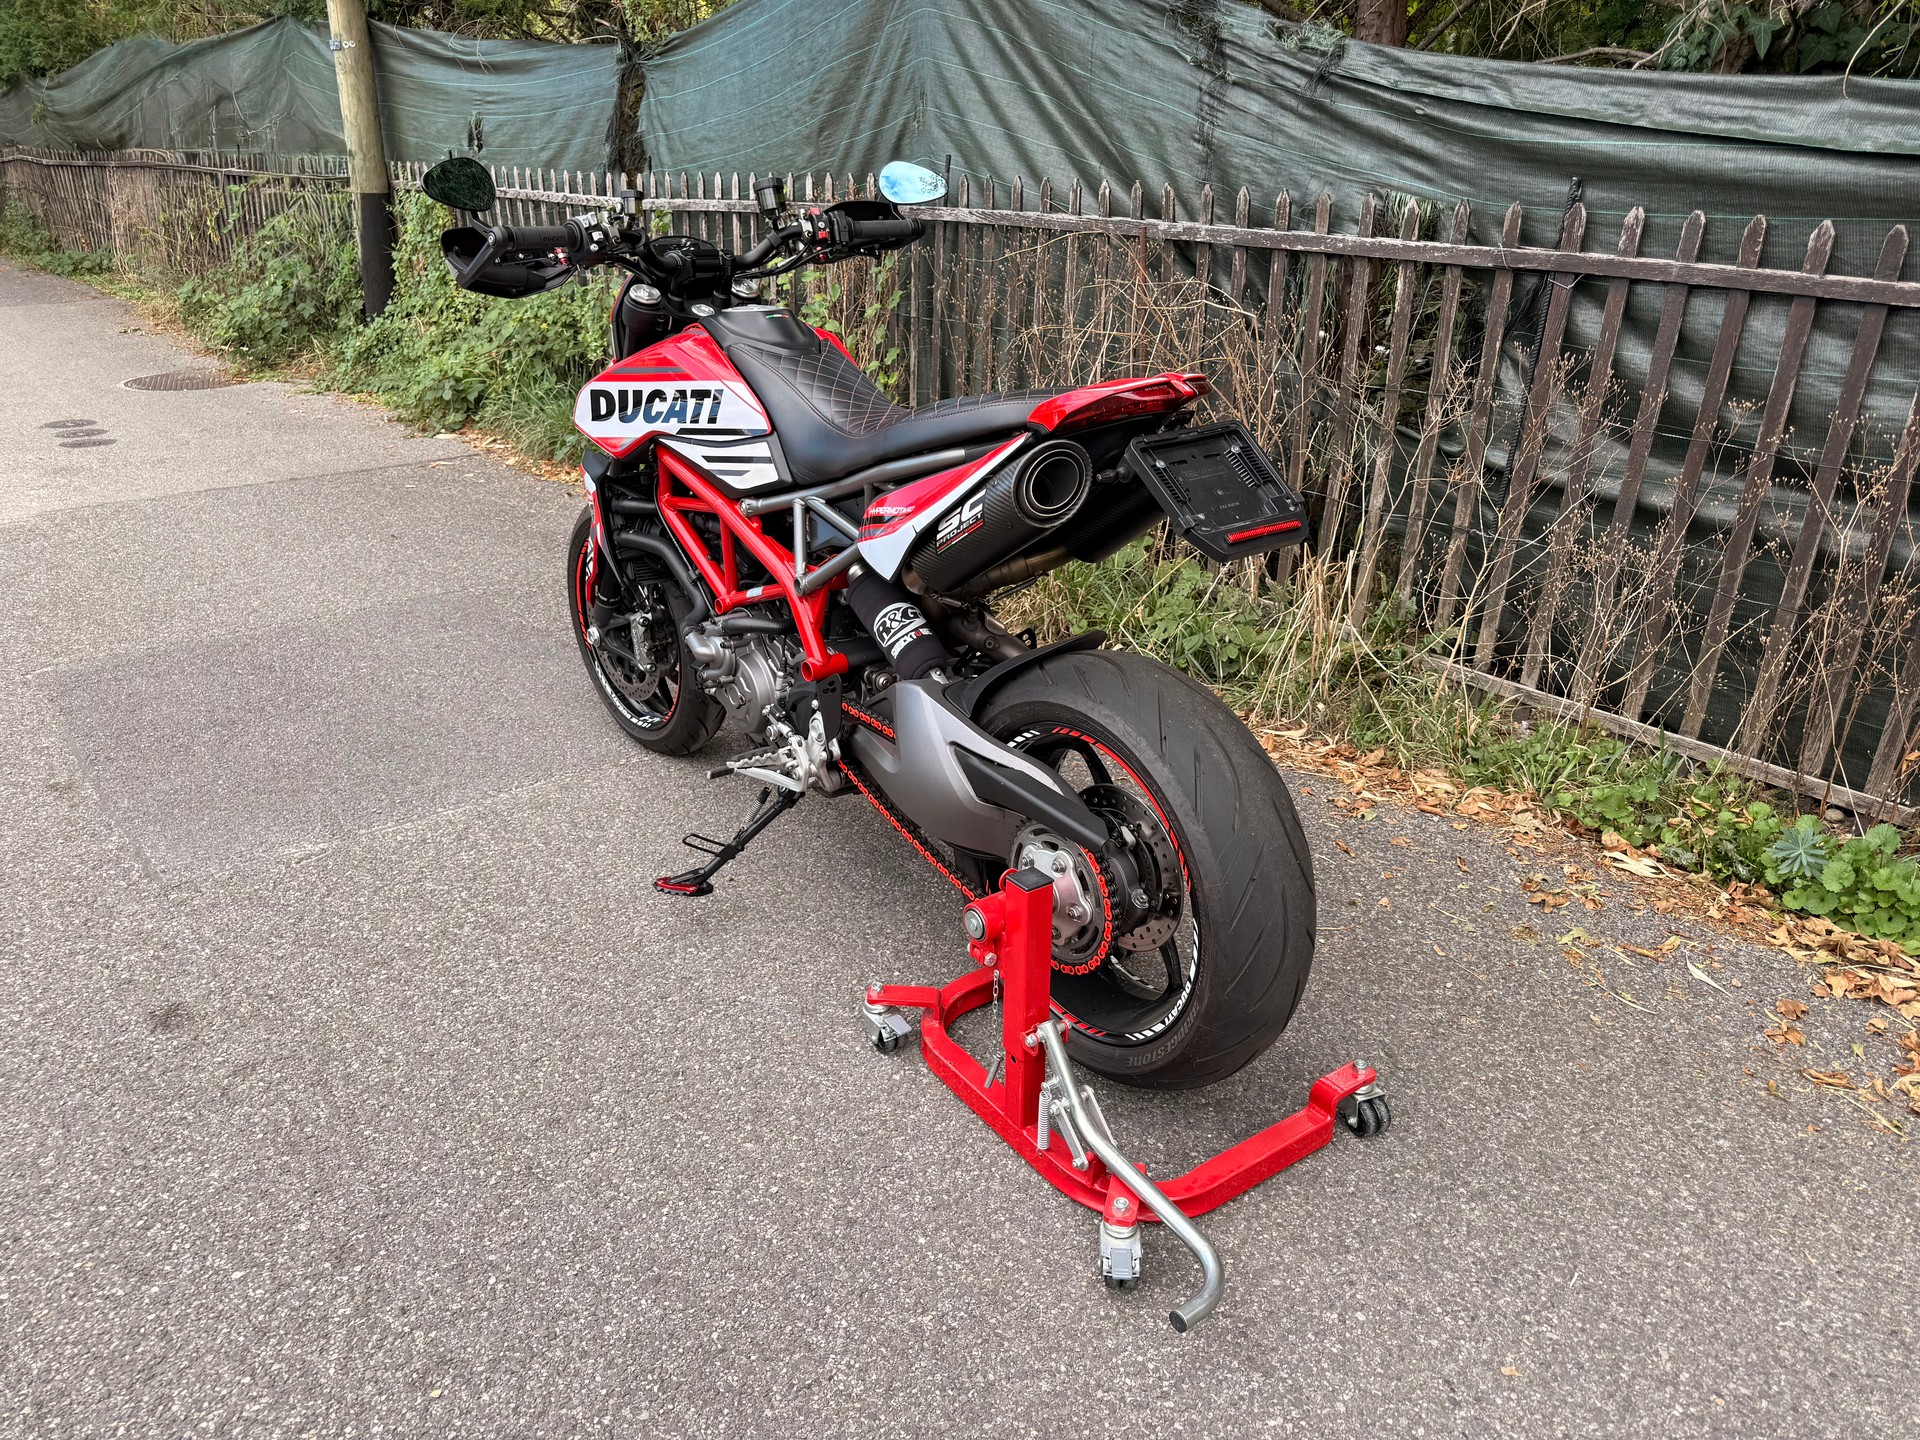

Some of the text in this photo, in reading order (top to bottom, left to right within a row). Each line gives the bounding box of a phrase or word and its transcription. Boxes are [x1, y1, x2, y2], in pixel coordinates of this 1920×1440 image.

[590, 389, 724, 424] DUCATI
[936, 511, 983, 547] PROJECT
[937, 488, 987, 540] SC
[876, 606, 922, 644] R&G
[1164, 981, 1191, 1026] DUCATI
[1124, 1001, 1200, 1067] BRIDGESTONE
